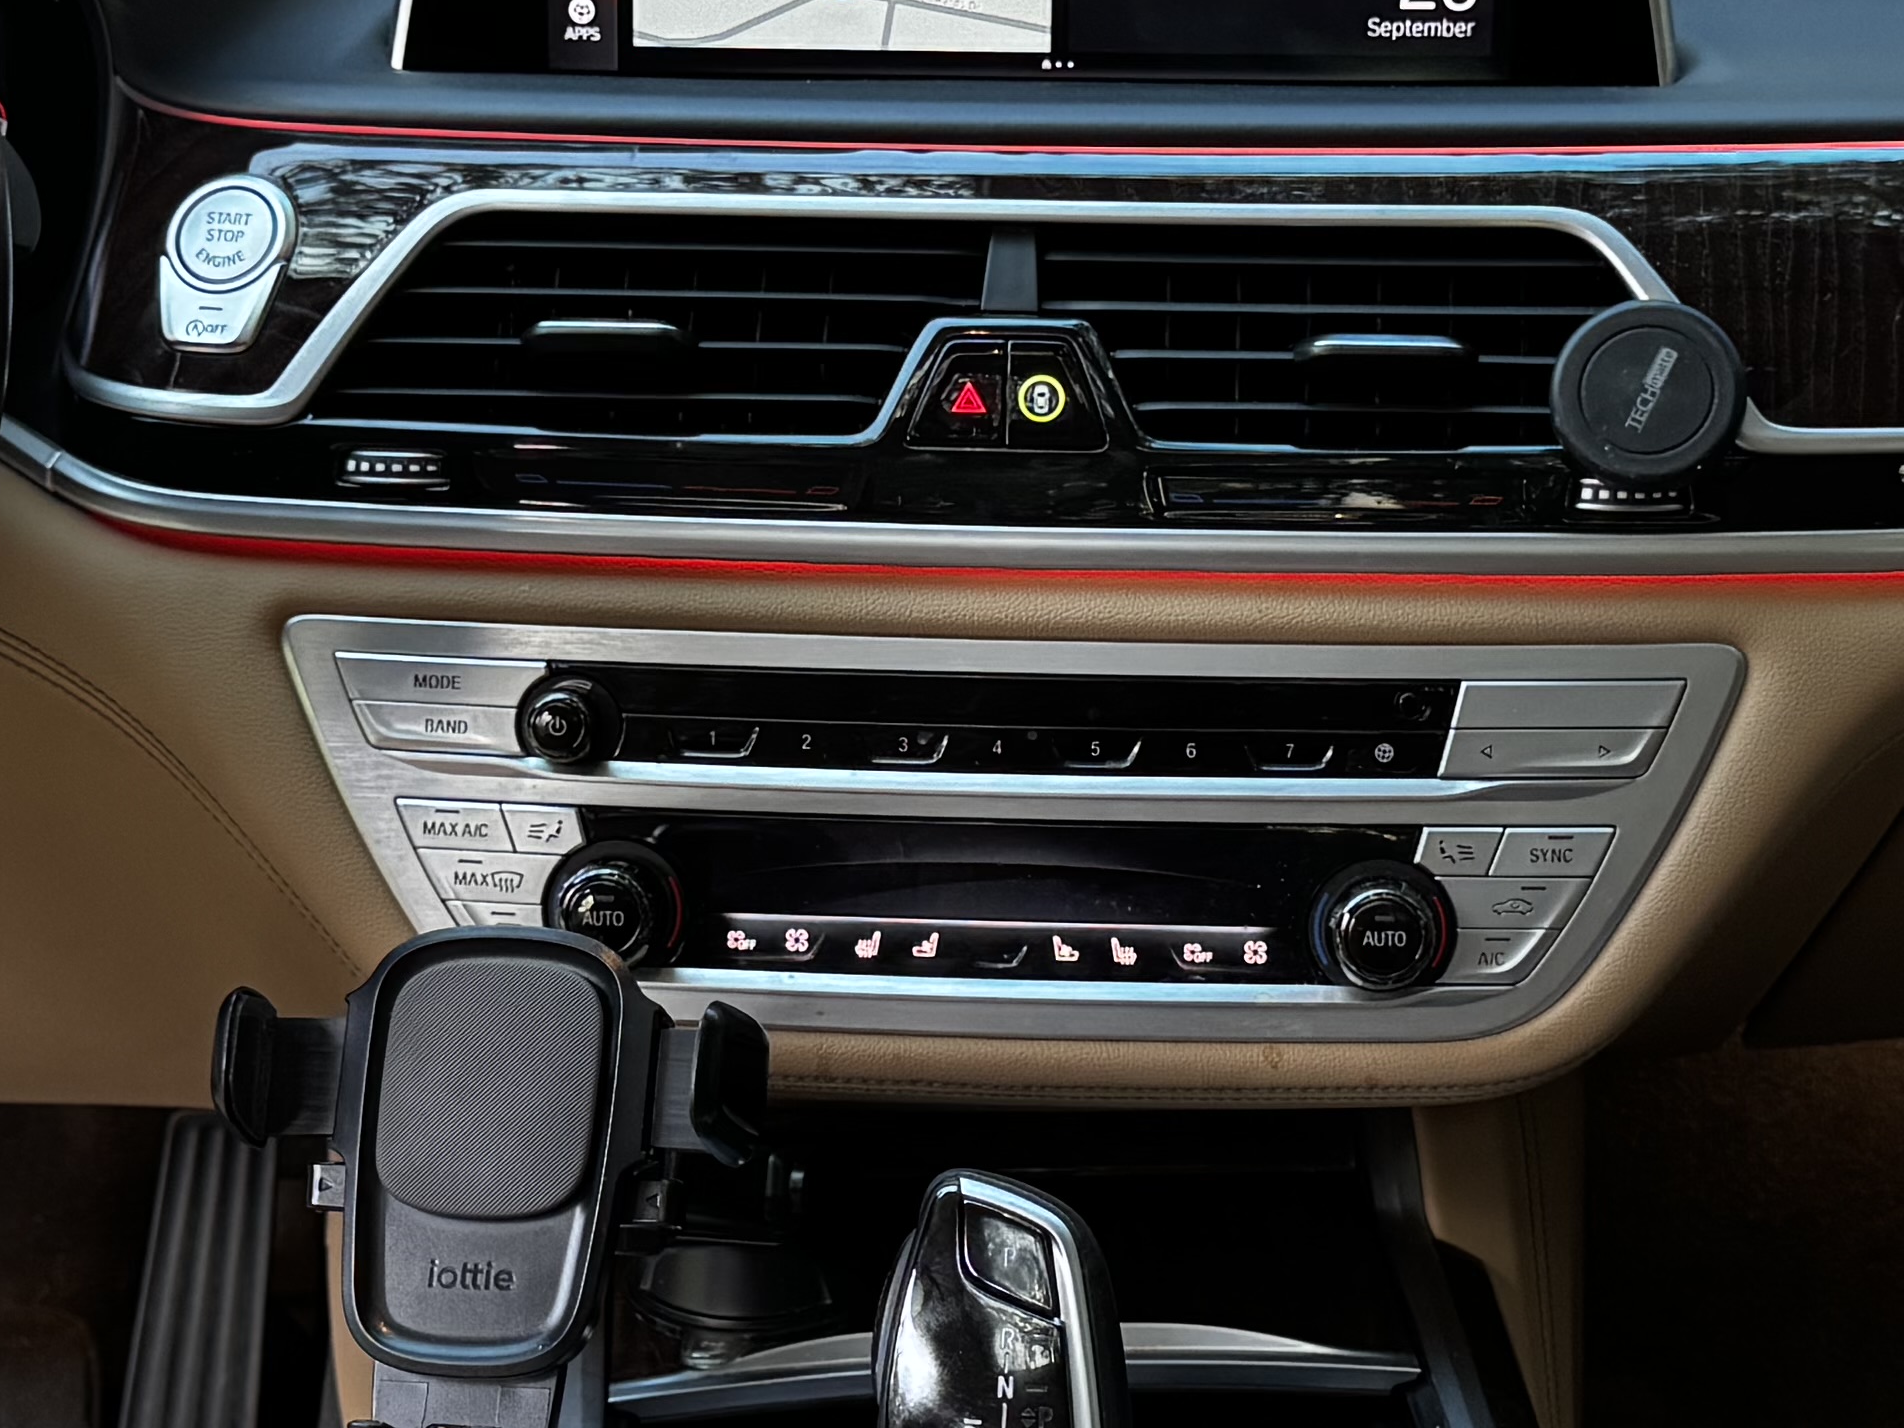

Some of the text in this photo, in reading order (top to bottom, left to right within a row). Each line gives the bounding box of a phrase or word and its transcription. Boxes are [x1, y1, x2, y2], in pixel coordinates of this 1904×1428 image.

[564, 27, 601, 42] APPS
[1367, 17, 1476, 41] September
[206, 211, 254, 226] START
[205, 228, 245, 243] STOP
[195, 247, 247, 268] ENGINE
[413, 673, 462, 690] MODE
[424, 718, 468, 734] BAND
[801, 734, 812, 750] 2
[898, 736, 909, 752] 3
[992, 739, 1002, 755] 4
[1090, 741, 1101, 757] 5
[1185, 742, 1197, 759] 6
[1285, 743, 1295, 759] 7
[422, 820, 489, 838] MAX A/C
[1529, 848, 1574, 863] SYNC
[454, 871, 490, 887] MAX
[582, 910, 625, 927] AUTO
[1362, 930, 1407, 947] AUTO
[1477, 952, 1506, 966] A/C
[1001, 1327, 1015, 1350] R
[997, 1375, 1014, 1400] N
